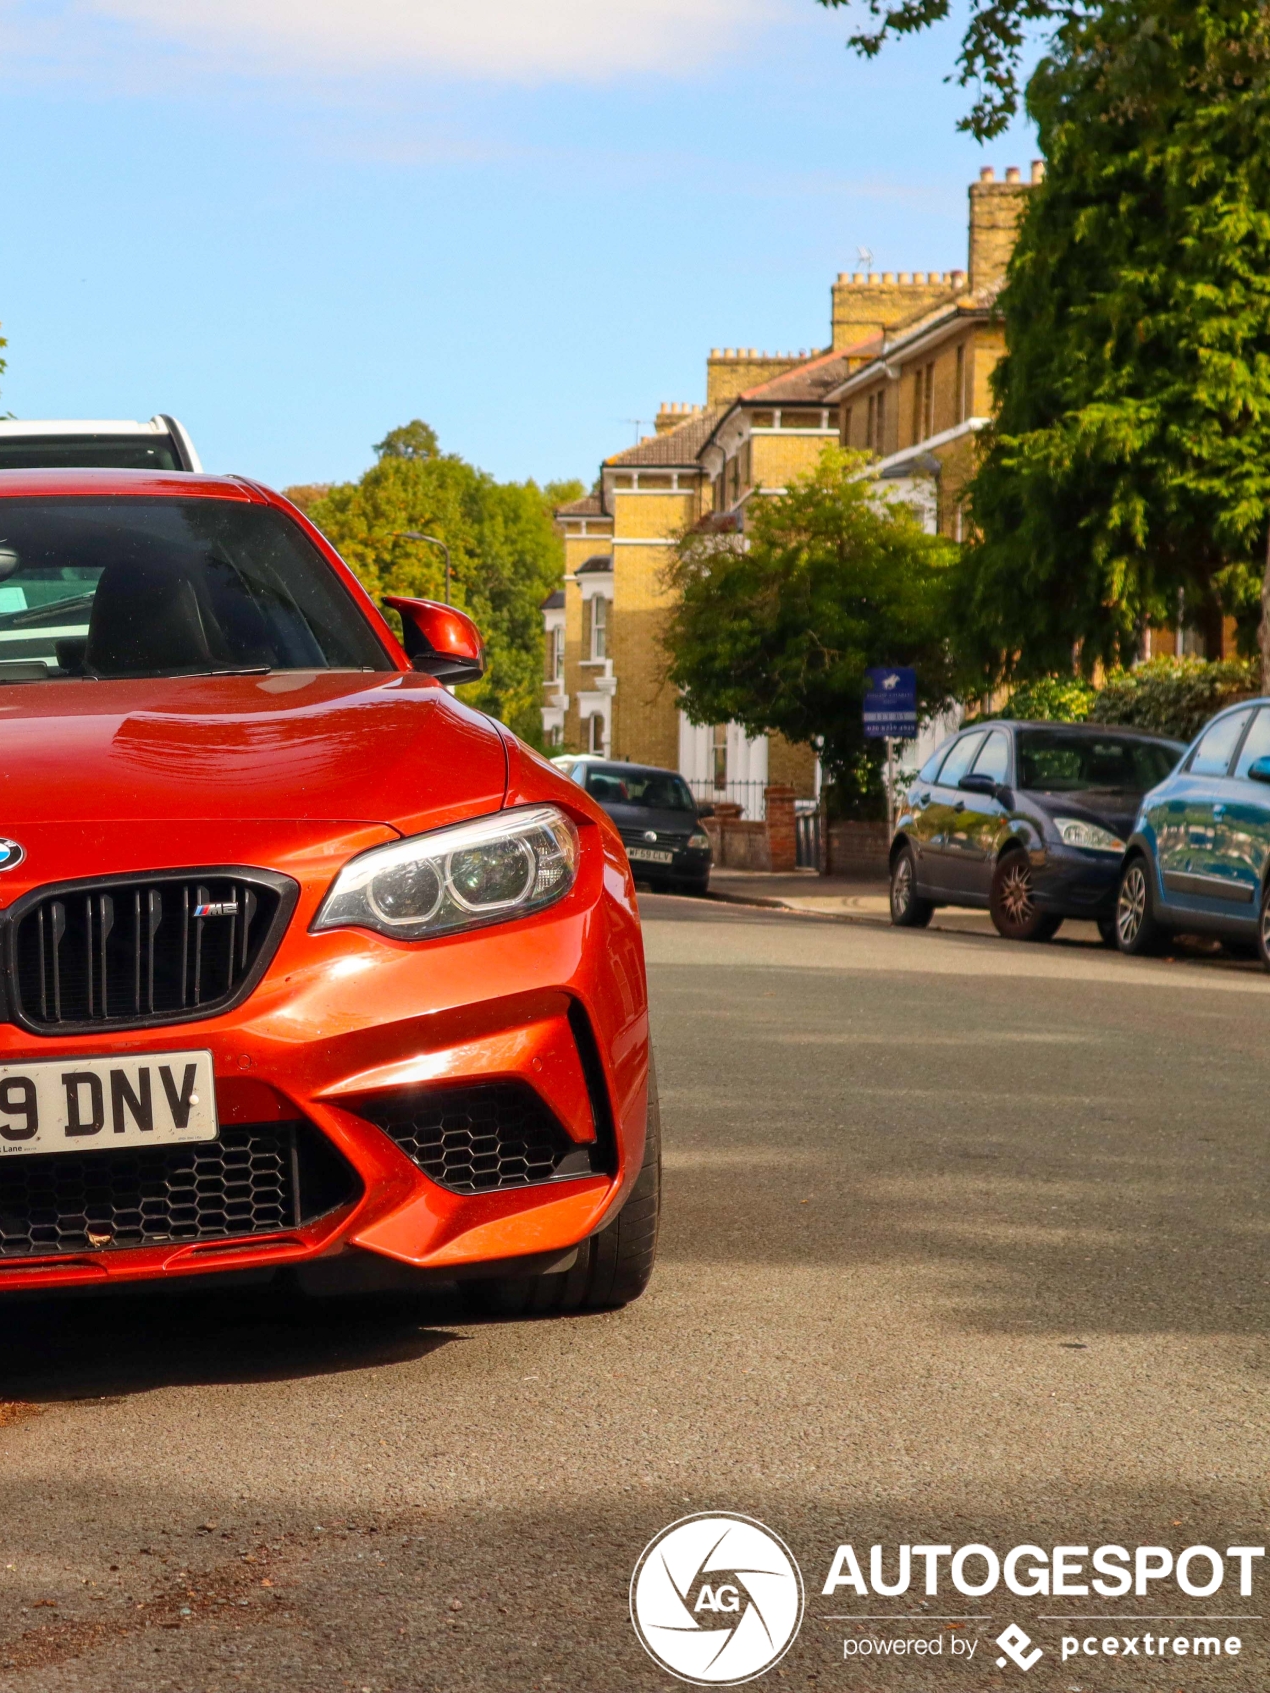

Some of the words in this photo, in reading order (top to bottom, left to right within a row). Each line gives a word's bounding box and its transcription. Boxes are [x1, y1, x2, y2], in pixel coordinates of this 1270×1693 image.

[652, 851, 670, 862] CLV
[205, 902, 238, 916] M2
[61, 1063, 197, 1138] DNV
[2, 1145, 23, 1153] Lane
